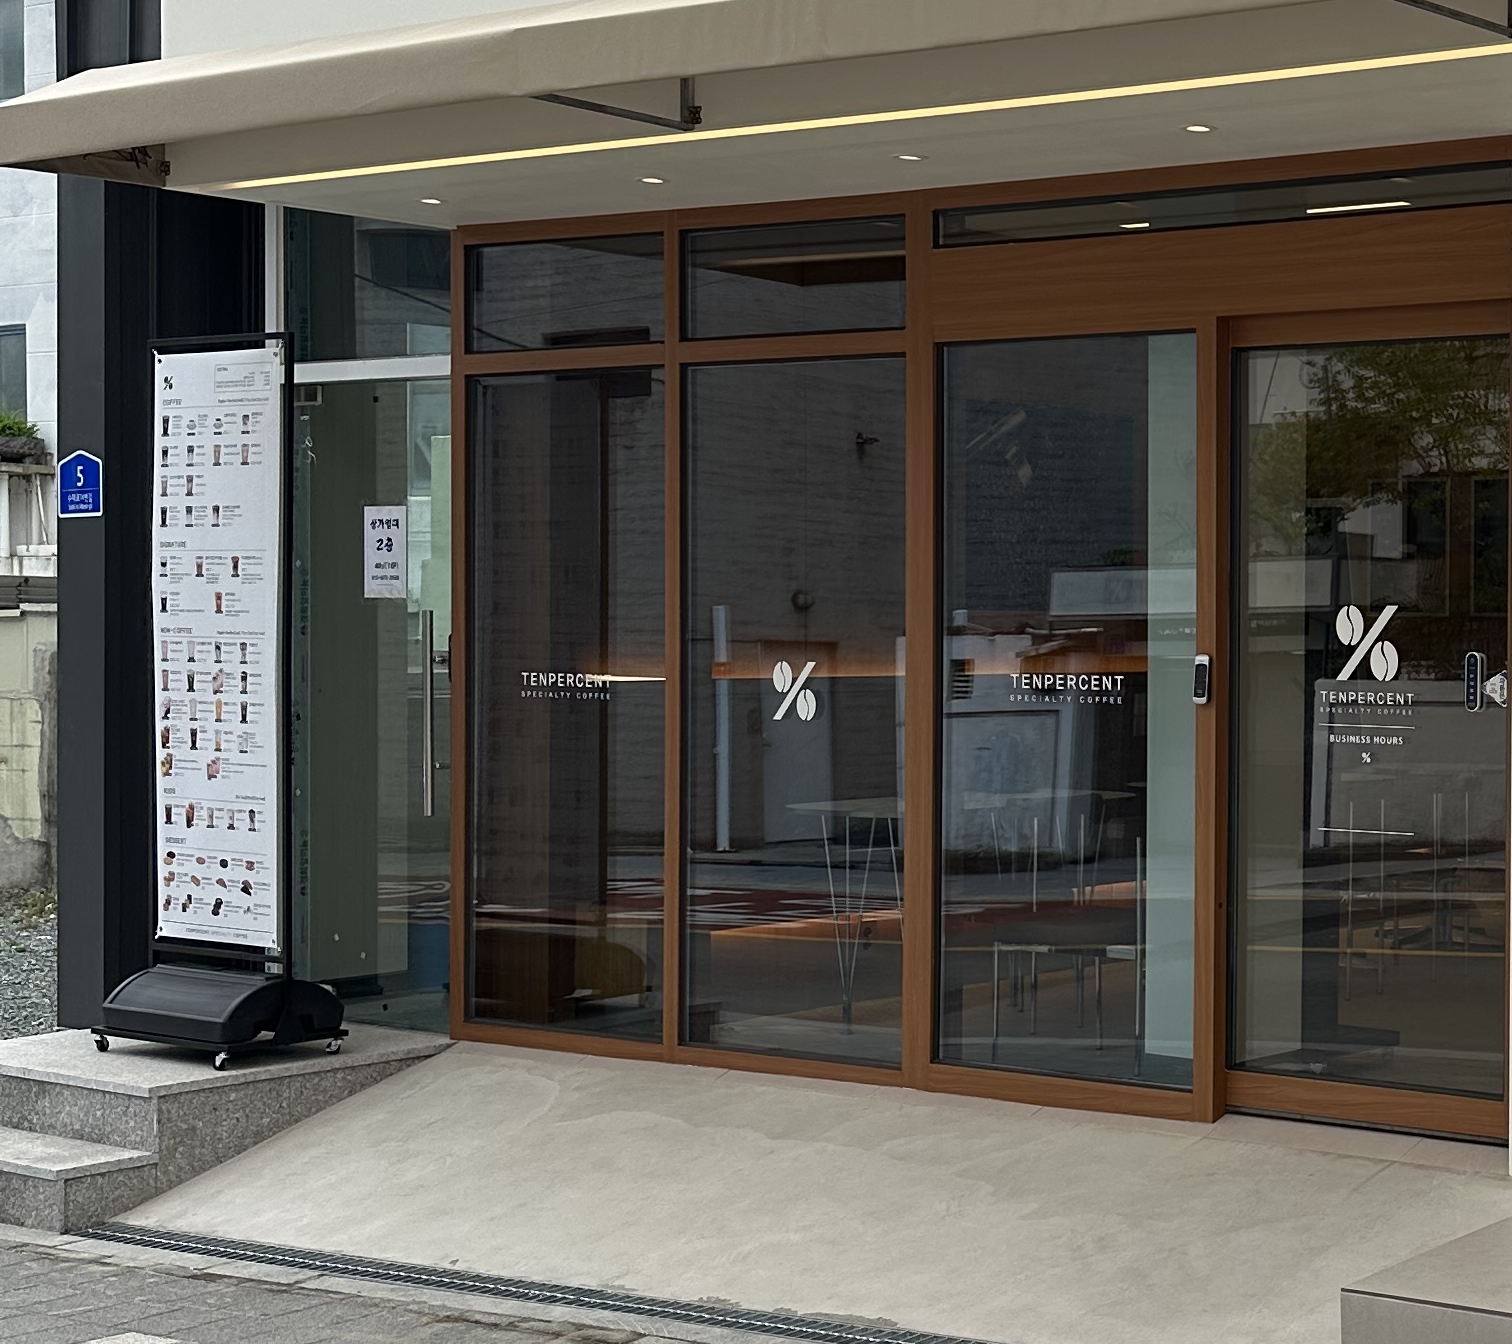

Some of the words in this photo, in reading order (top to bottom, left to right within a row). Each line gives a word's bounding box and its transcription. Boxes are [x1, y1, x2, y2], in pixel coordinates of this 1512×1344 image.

[76, 465, 84, 487] 5
[521, 671, 611, 689] TENPERCENT
[1010, 673, 1124, 691] TENPERCENT
[1009, 694, 1072, 704] SPECIALTY
[1320, 690, 1415, 706] TENPERCENT
[1329, 734, 1371, 744] BUSINESS
[1374, 736, 1404, 746] HOURS
